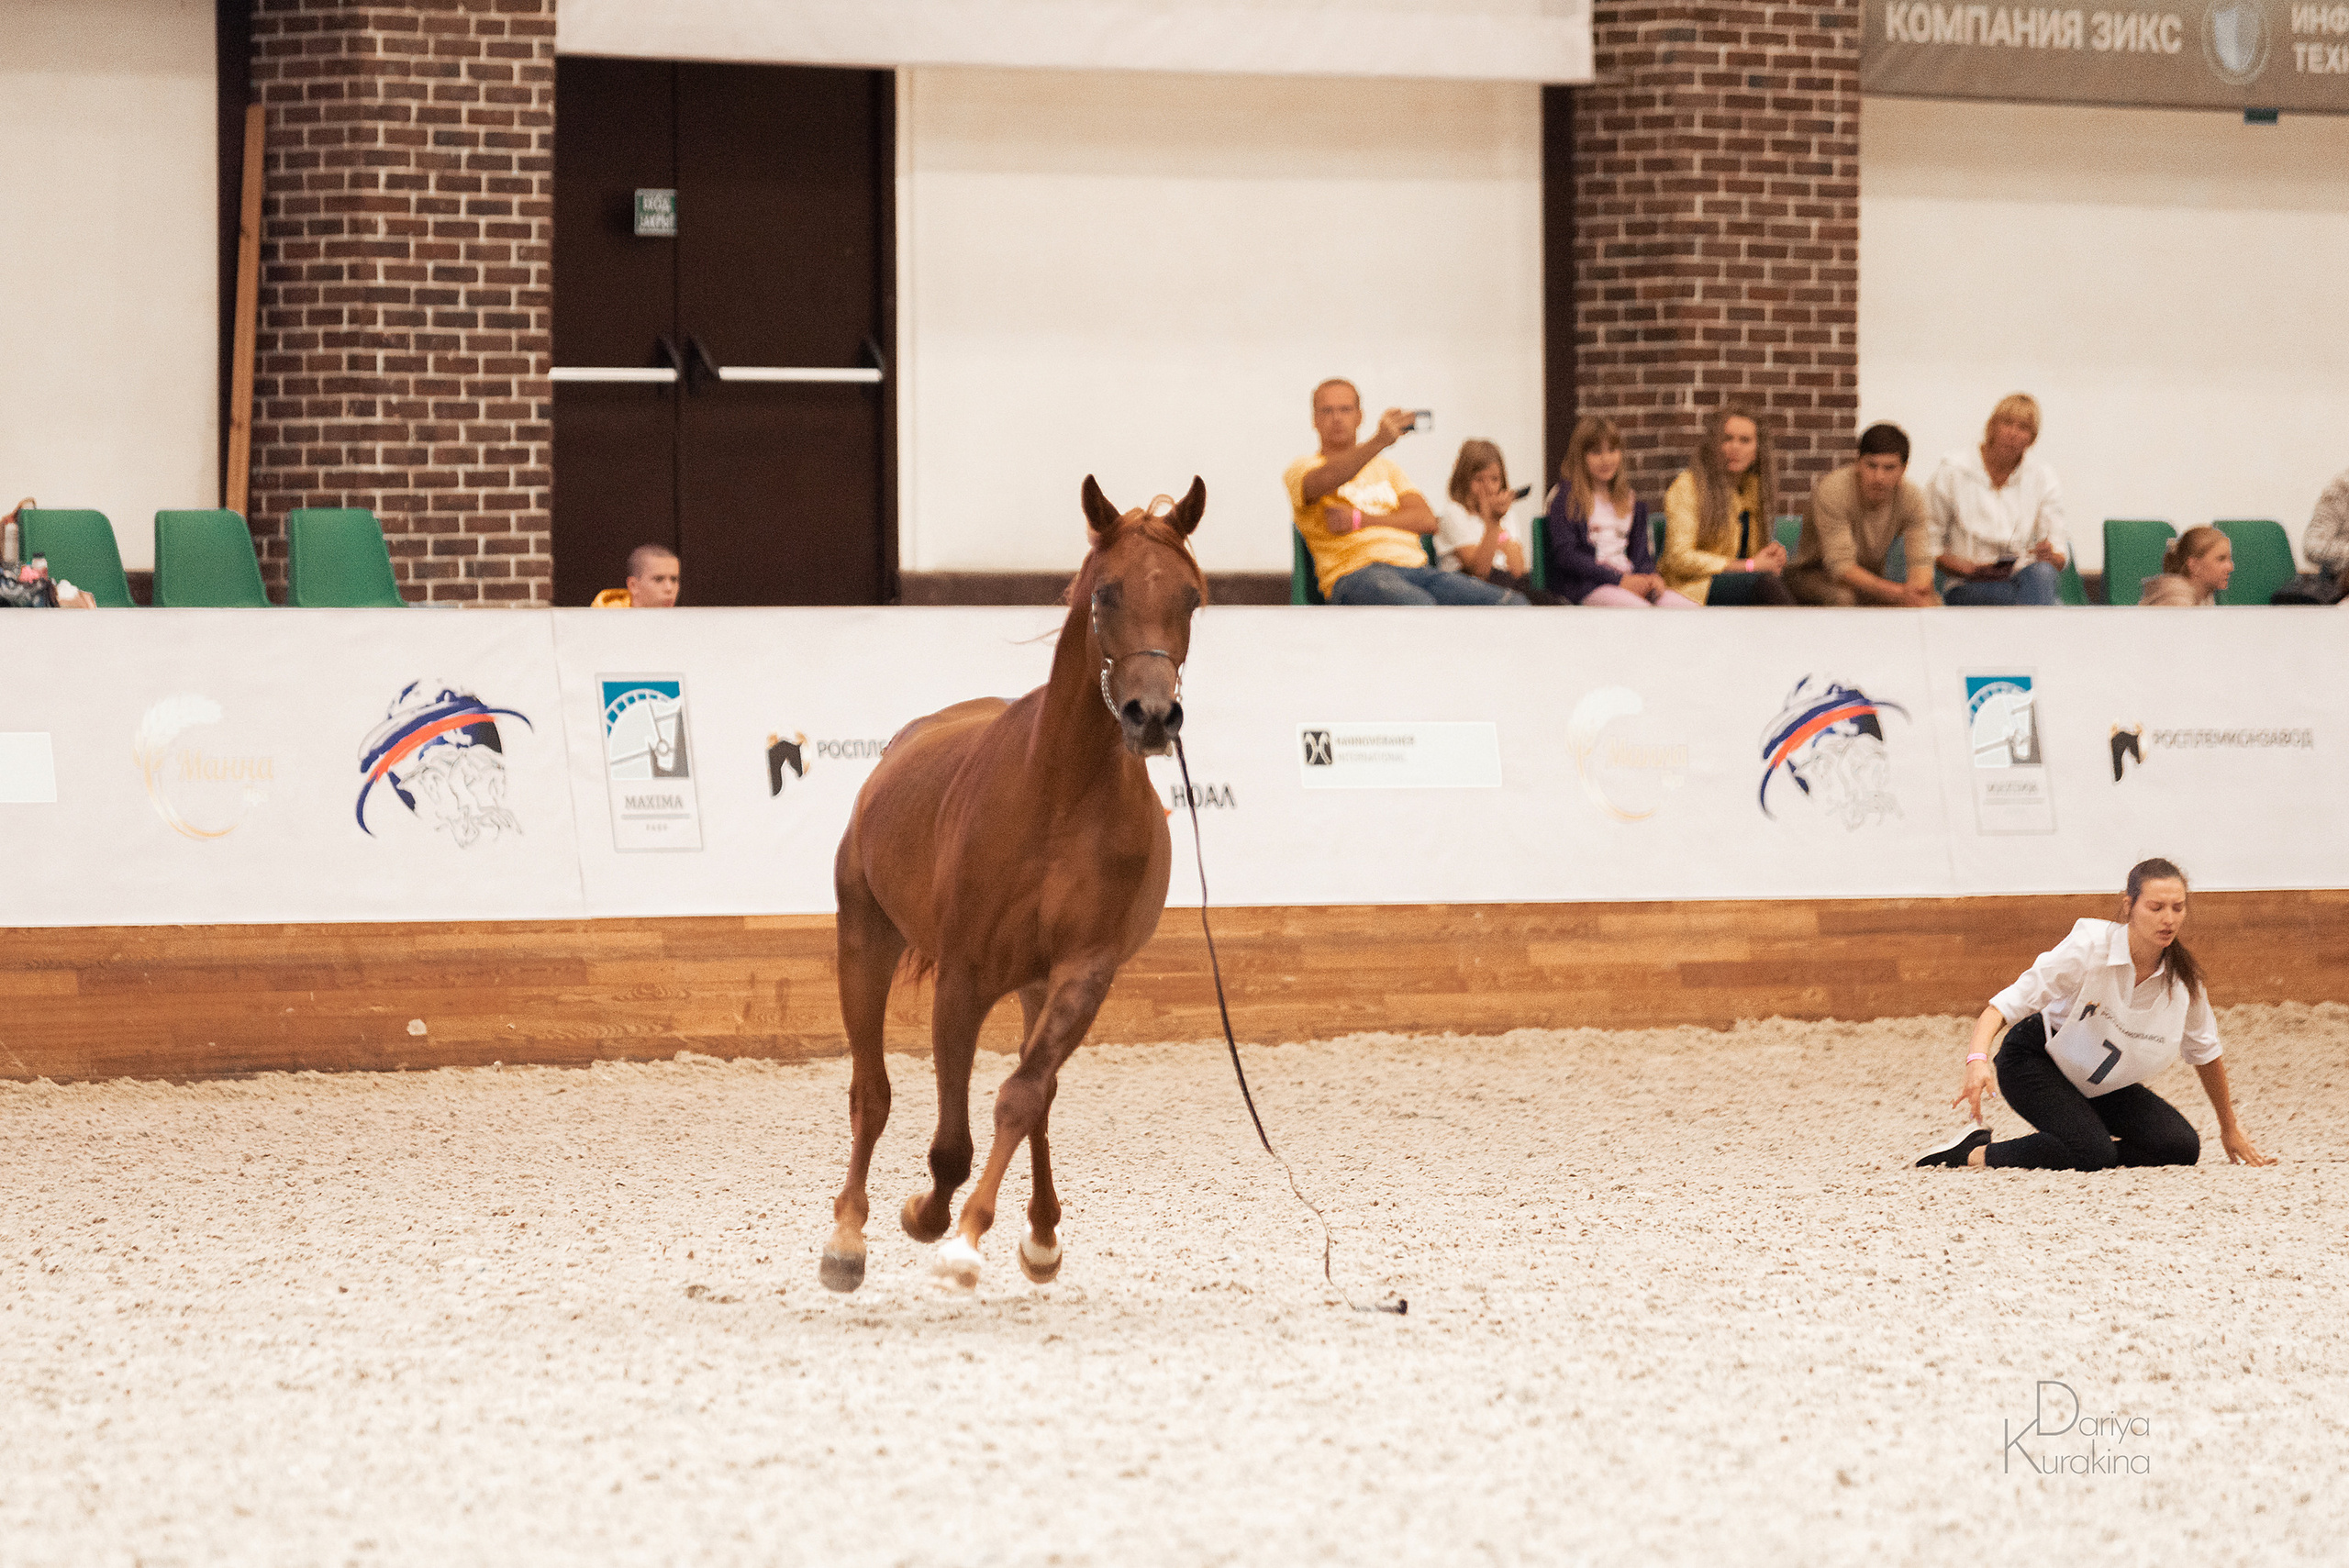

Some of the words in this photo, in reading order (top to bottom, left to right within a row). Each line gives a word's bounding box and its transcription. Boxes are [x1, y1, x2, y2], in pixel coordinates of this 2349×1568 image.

[1885, 2, 2083, 49] КОМПАНИЯ
[2091, 11, 2182, 54] ЗИКС
[176, 749, 274, 782] Манна
[625, 795, 684, 809] MAXIMA
[2087, 1039, 2121, 1084] 7
